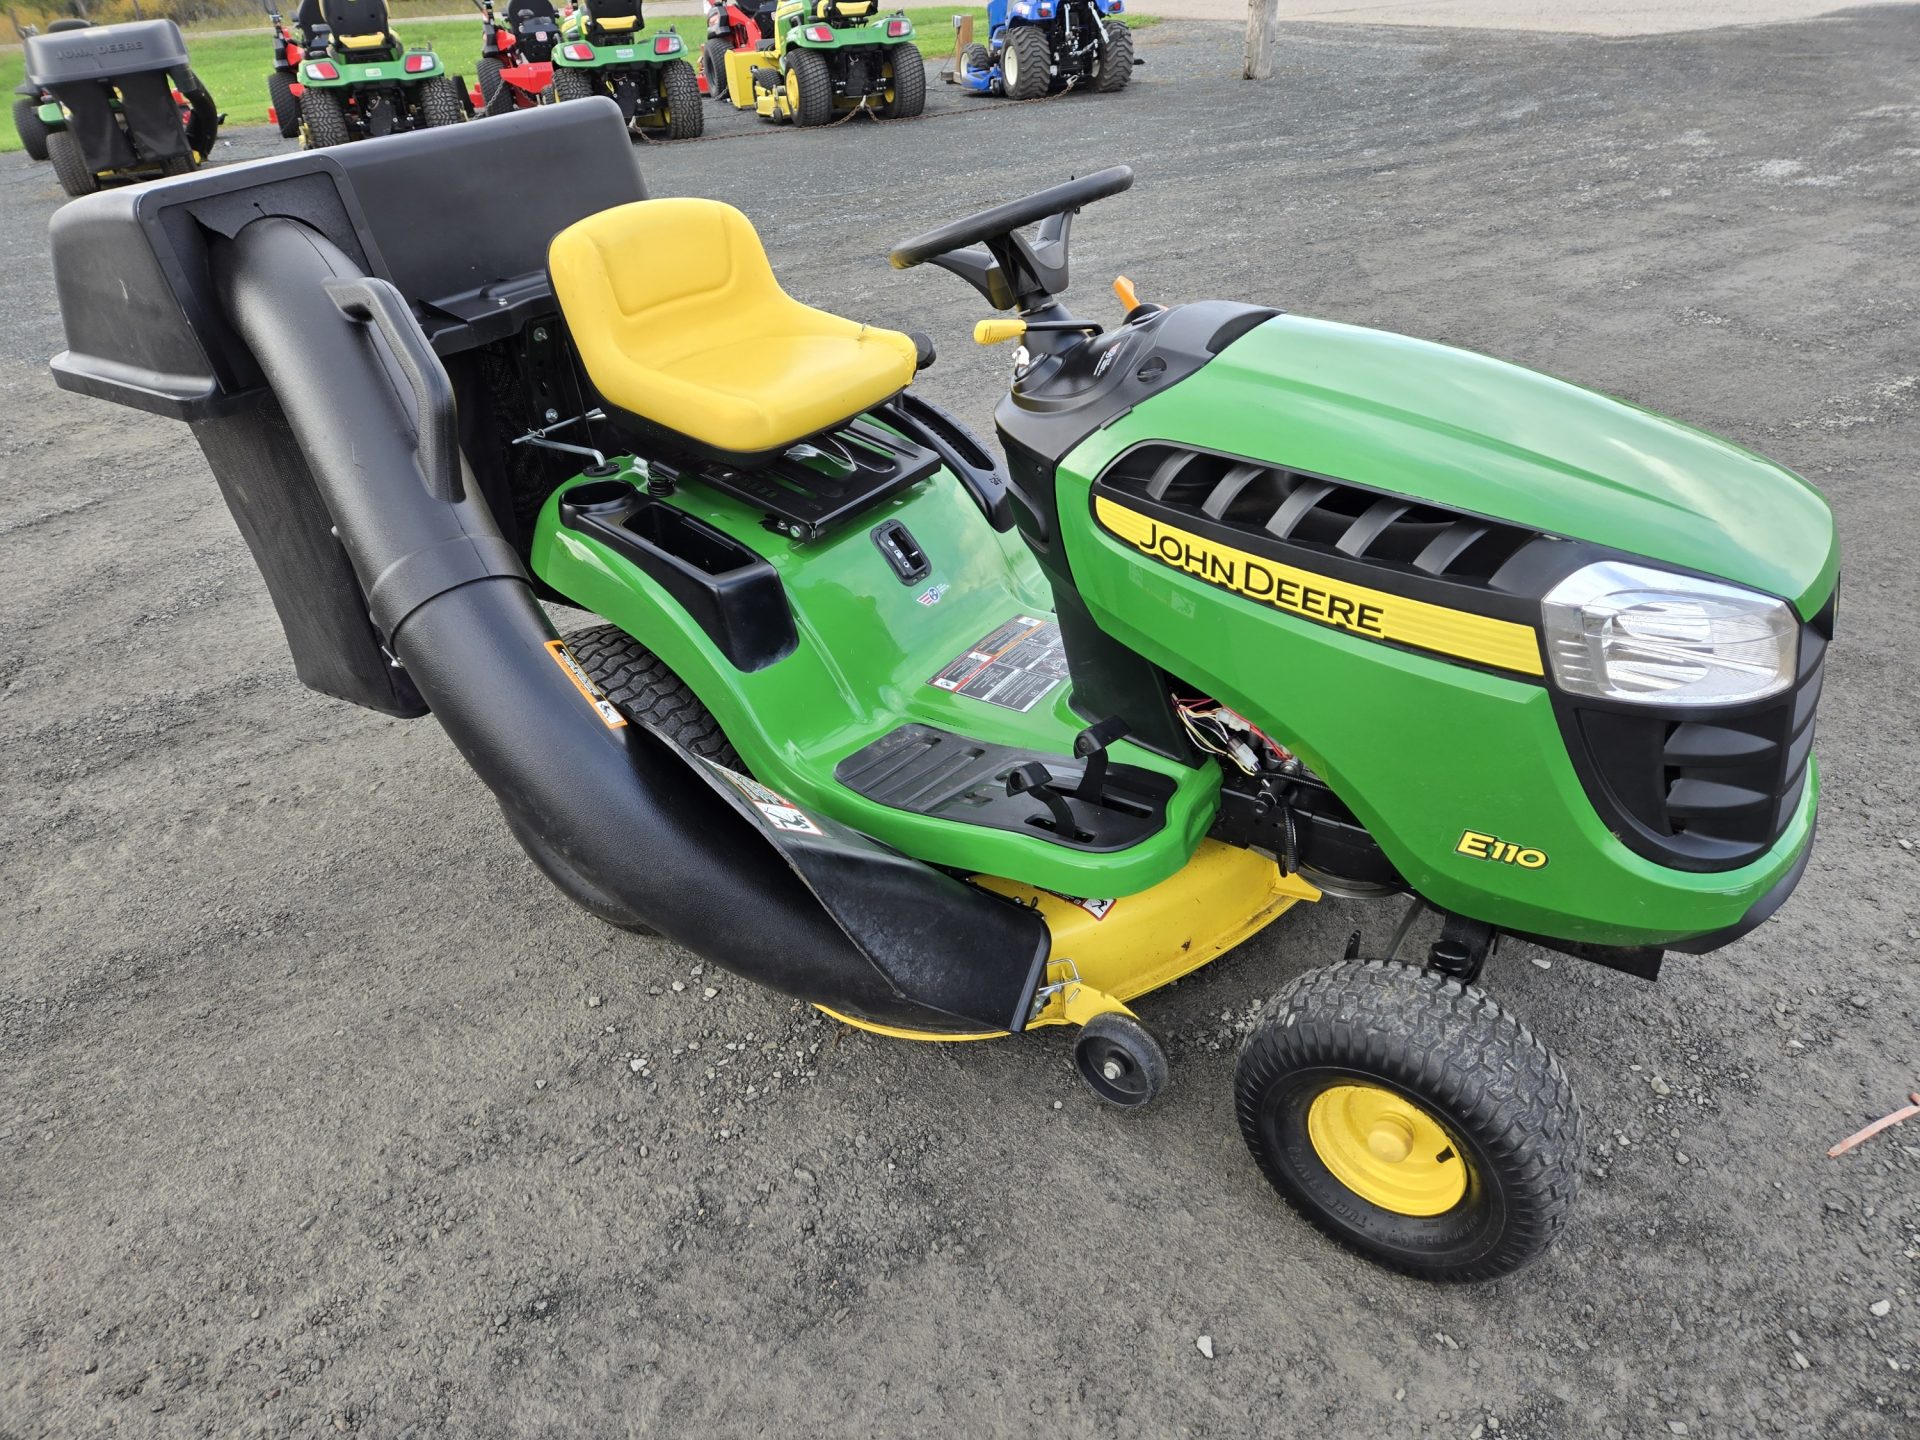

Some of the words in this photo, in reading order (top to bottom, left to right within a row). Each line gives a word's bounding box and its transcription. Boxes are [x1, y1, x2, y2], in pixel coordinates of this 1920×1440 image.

[56, 47, 94, 60] JOHN
[97, 41, 144, 56] DEERE
[1139, 523, 1235, 586] JOHN
[1243, 560, 1385, 634] DEERE
[1455, 830, 1549, 870] E110
